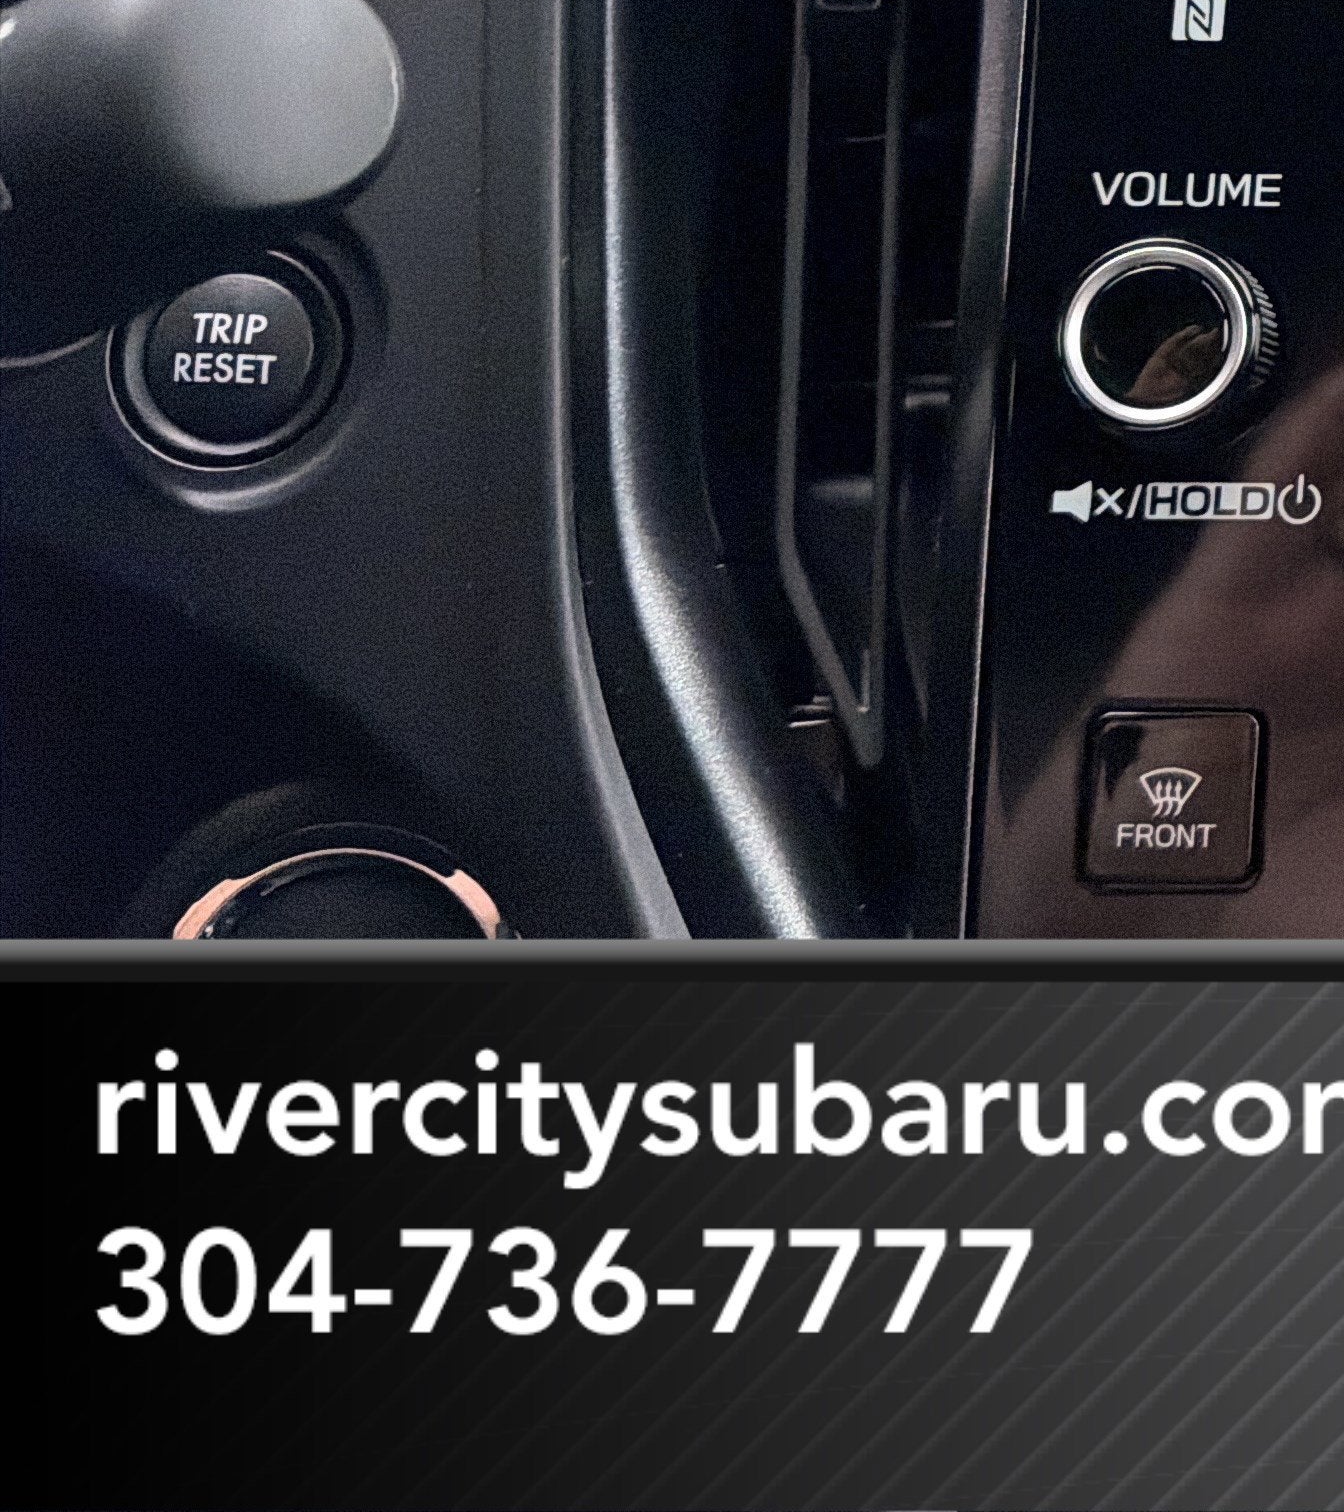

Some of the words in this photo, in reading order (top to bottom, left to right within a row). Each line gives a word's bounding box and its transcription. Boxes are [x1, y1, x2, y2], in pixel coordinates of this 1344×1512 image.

[1092, 171, 1283, 207] VOLUME
[193, 313, 268, 345] TRIP
[173, 352, 278, 385] RESET
[1116, 823, 1218, 849] FRONT
